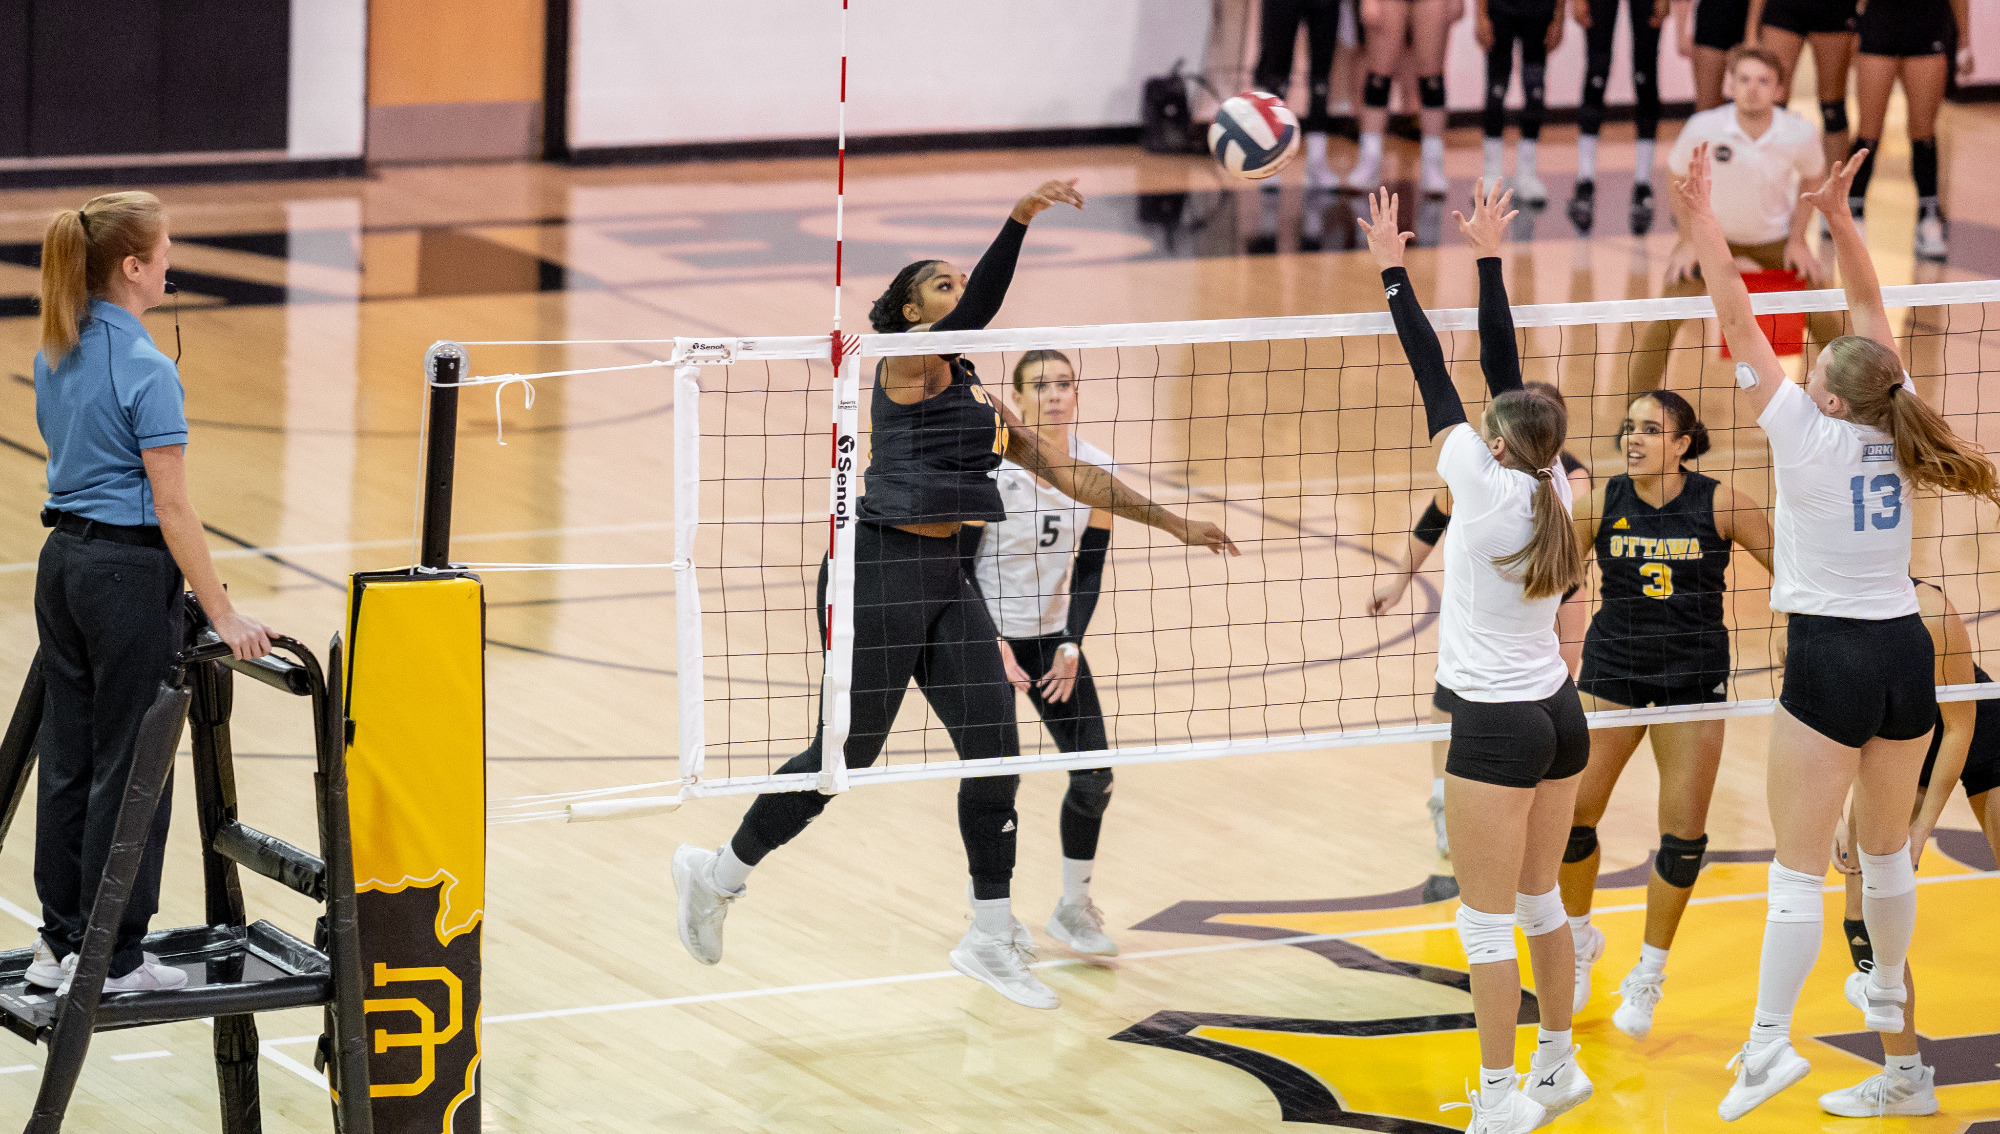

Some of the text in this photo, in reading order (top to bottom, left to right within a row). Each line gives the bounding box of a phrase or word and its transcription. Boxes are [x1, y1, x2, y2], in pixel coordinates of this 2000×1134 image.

[836, 457, 852, 529] Senoh
[1850, 473, 1902, 531] 13
[1039, 515, 1061, 547] 5
[1610, 535, 1703, 560] OTTAWA
[1639, 562, 1674, 599] 3
